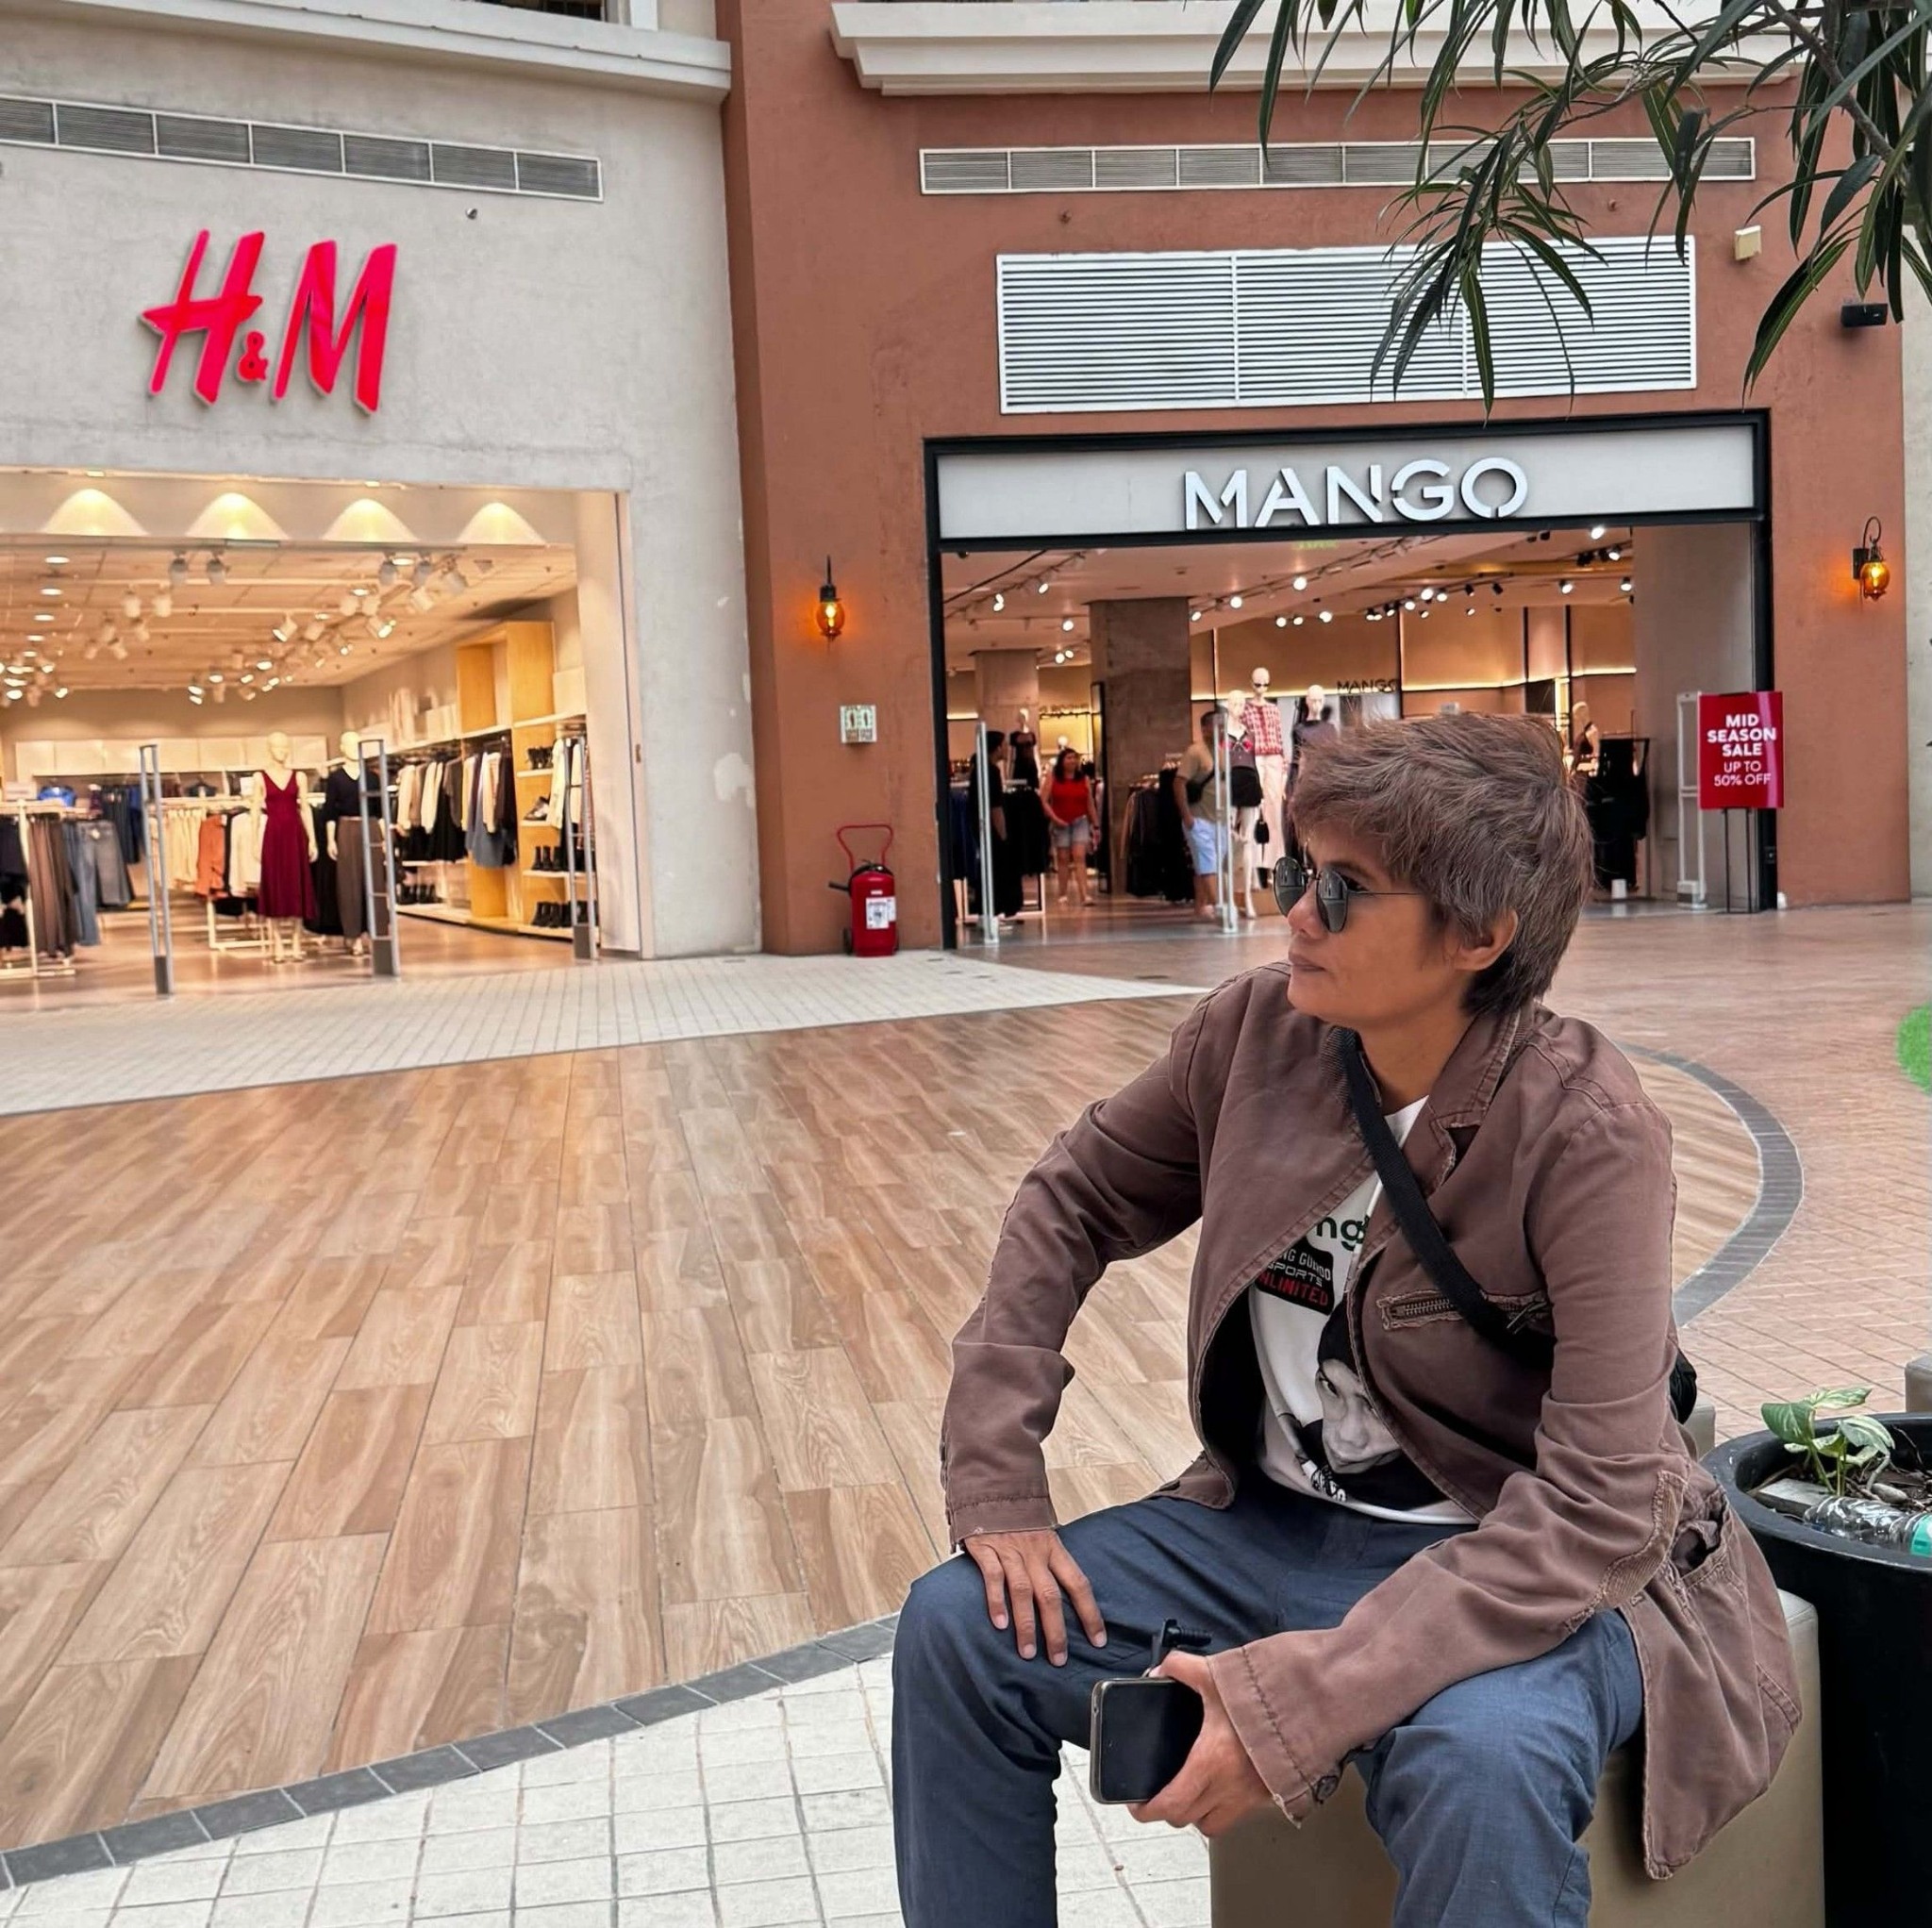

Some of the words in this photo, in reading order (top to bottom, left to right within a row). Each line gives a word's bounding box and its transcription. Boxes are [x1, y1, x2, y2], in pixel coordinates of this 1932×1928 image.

[141, 228, 397, 413] H&M
[1184, 457, 1528, 530] MANGO
[1725, 713, 1759, 728] MID
[1707, 727, 1776, 743] SEASON
[1722, 742, 1762, 757] SALE
[1724, 761, 1741, 773] UP
[1743, 760, 1761, 773] TO
[1714, 774, 1743, 787] 50%
[1744, 773, 1772, 786] OFF
